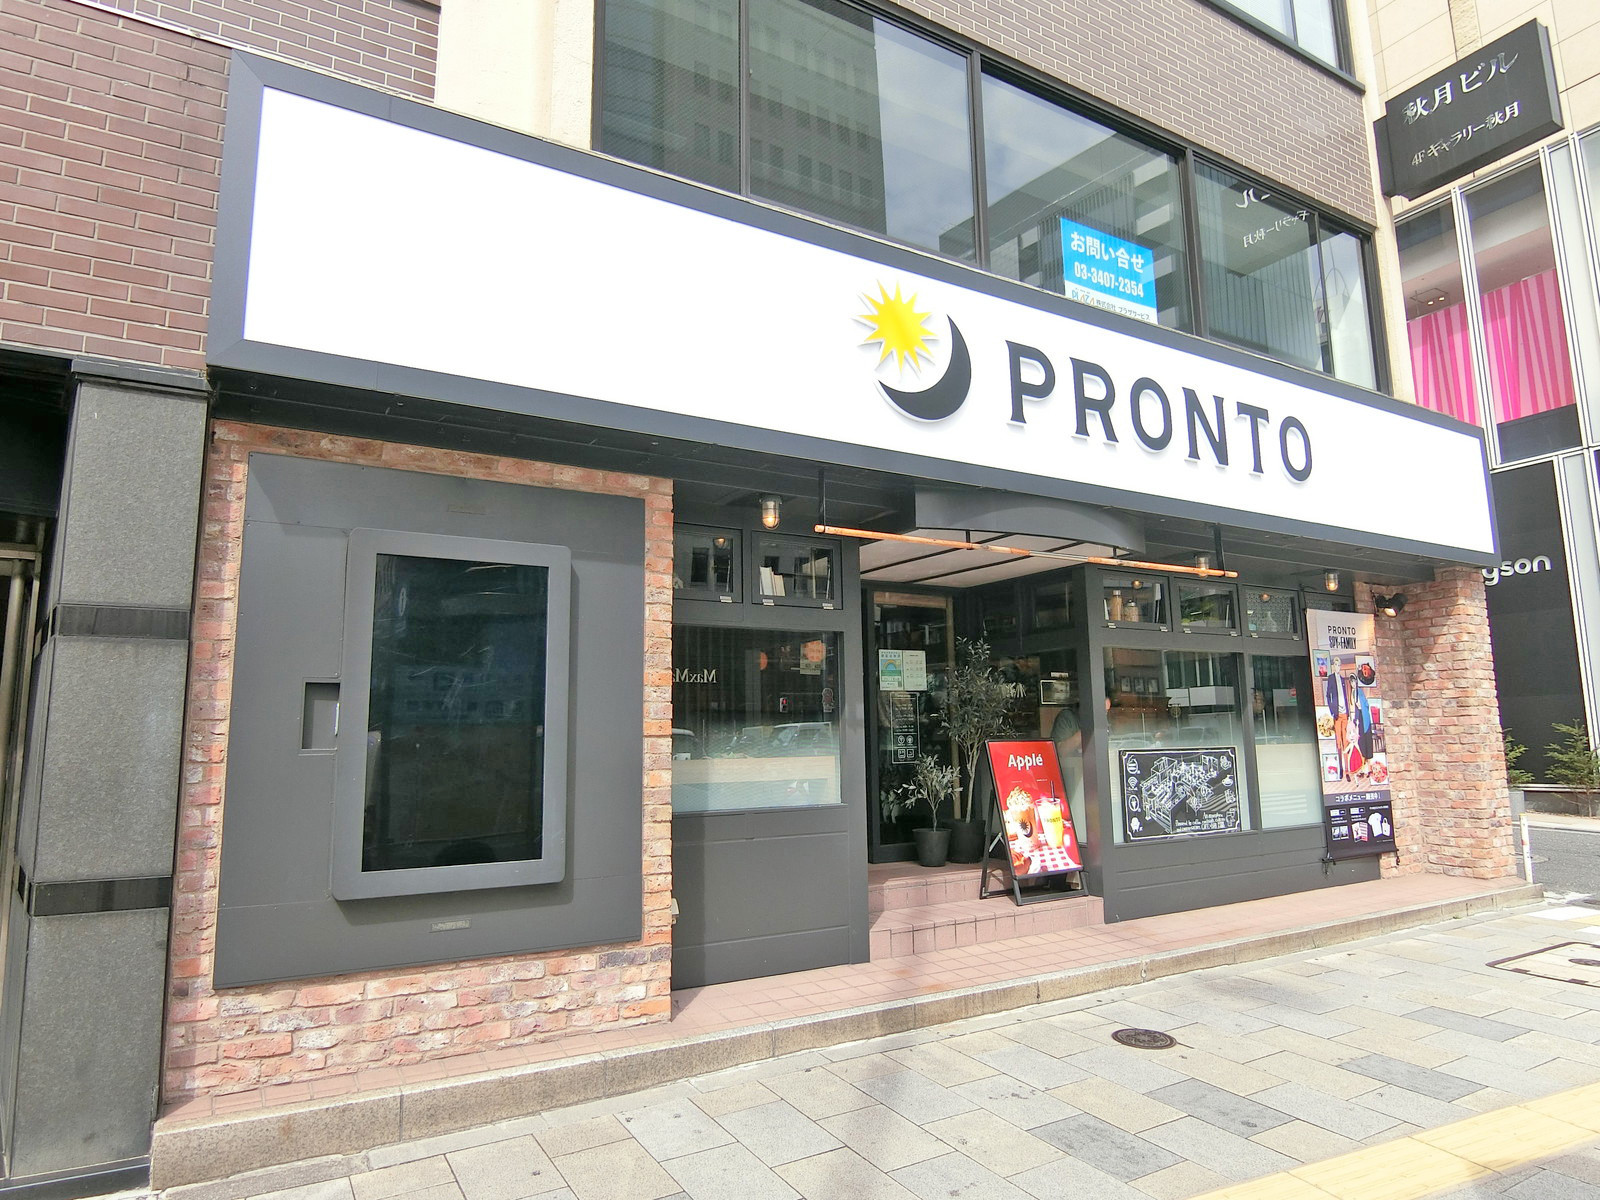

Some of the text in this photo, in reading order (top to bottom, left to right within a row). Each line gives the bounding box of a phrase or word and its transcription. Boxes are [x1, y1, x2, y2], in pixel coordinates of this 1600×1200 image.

[1070, 231, 1145, 273] お問い合せ
[1073, 261, 1144, 298] 03-3407-2354
[1005, 340, 1313, 482] PRONTO
[1327, 625, 1357, 636] PRONTO
